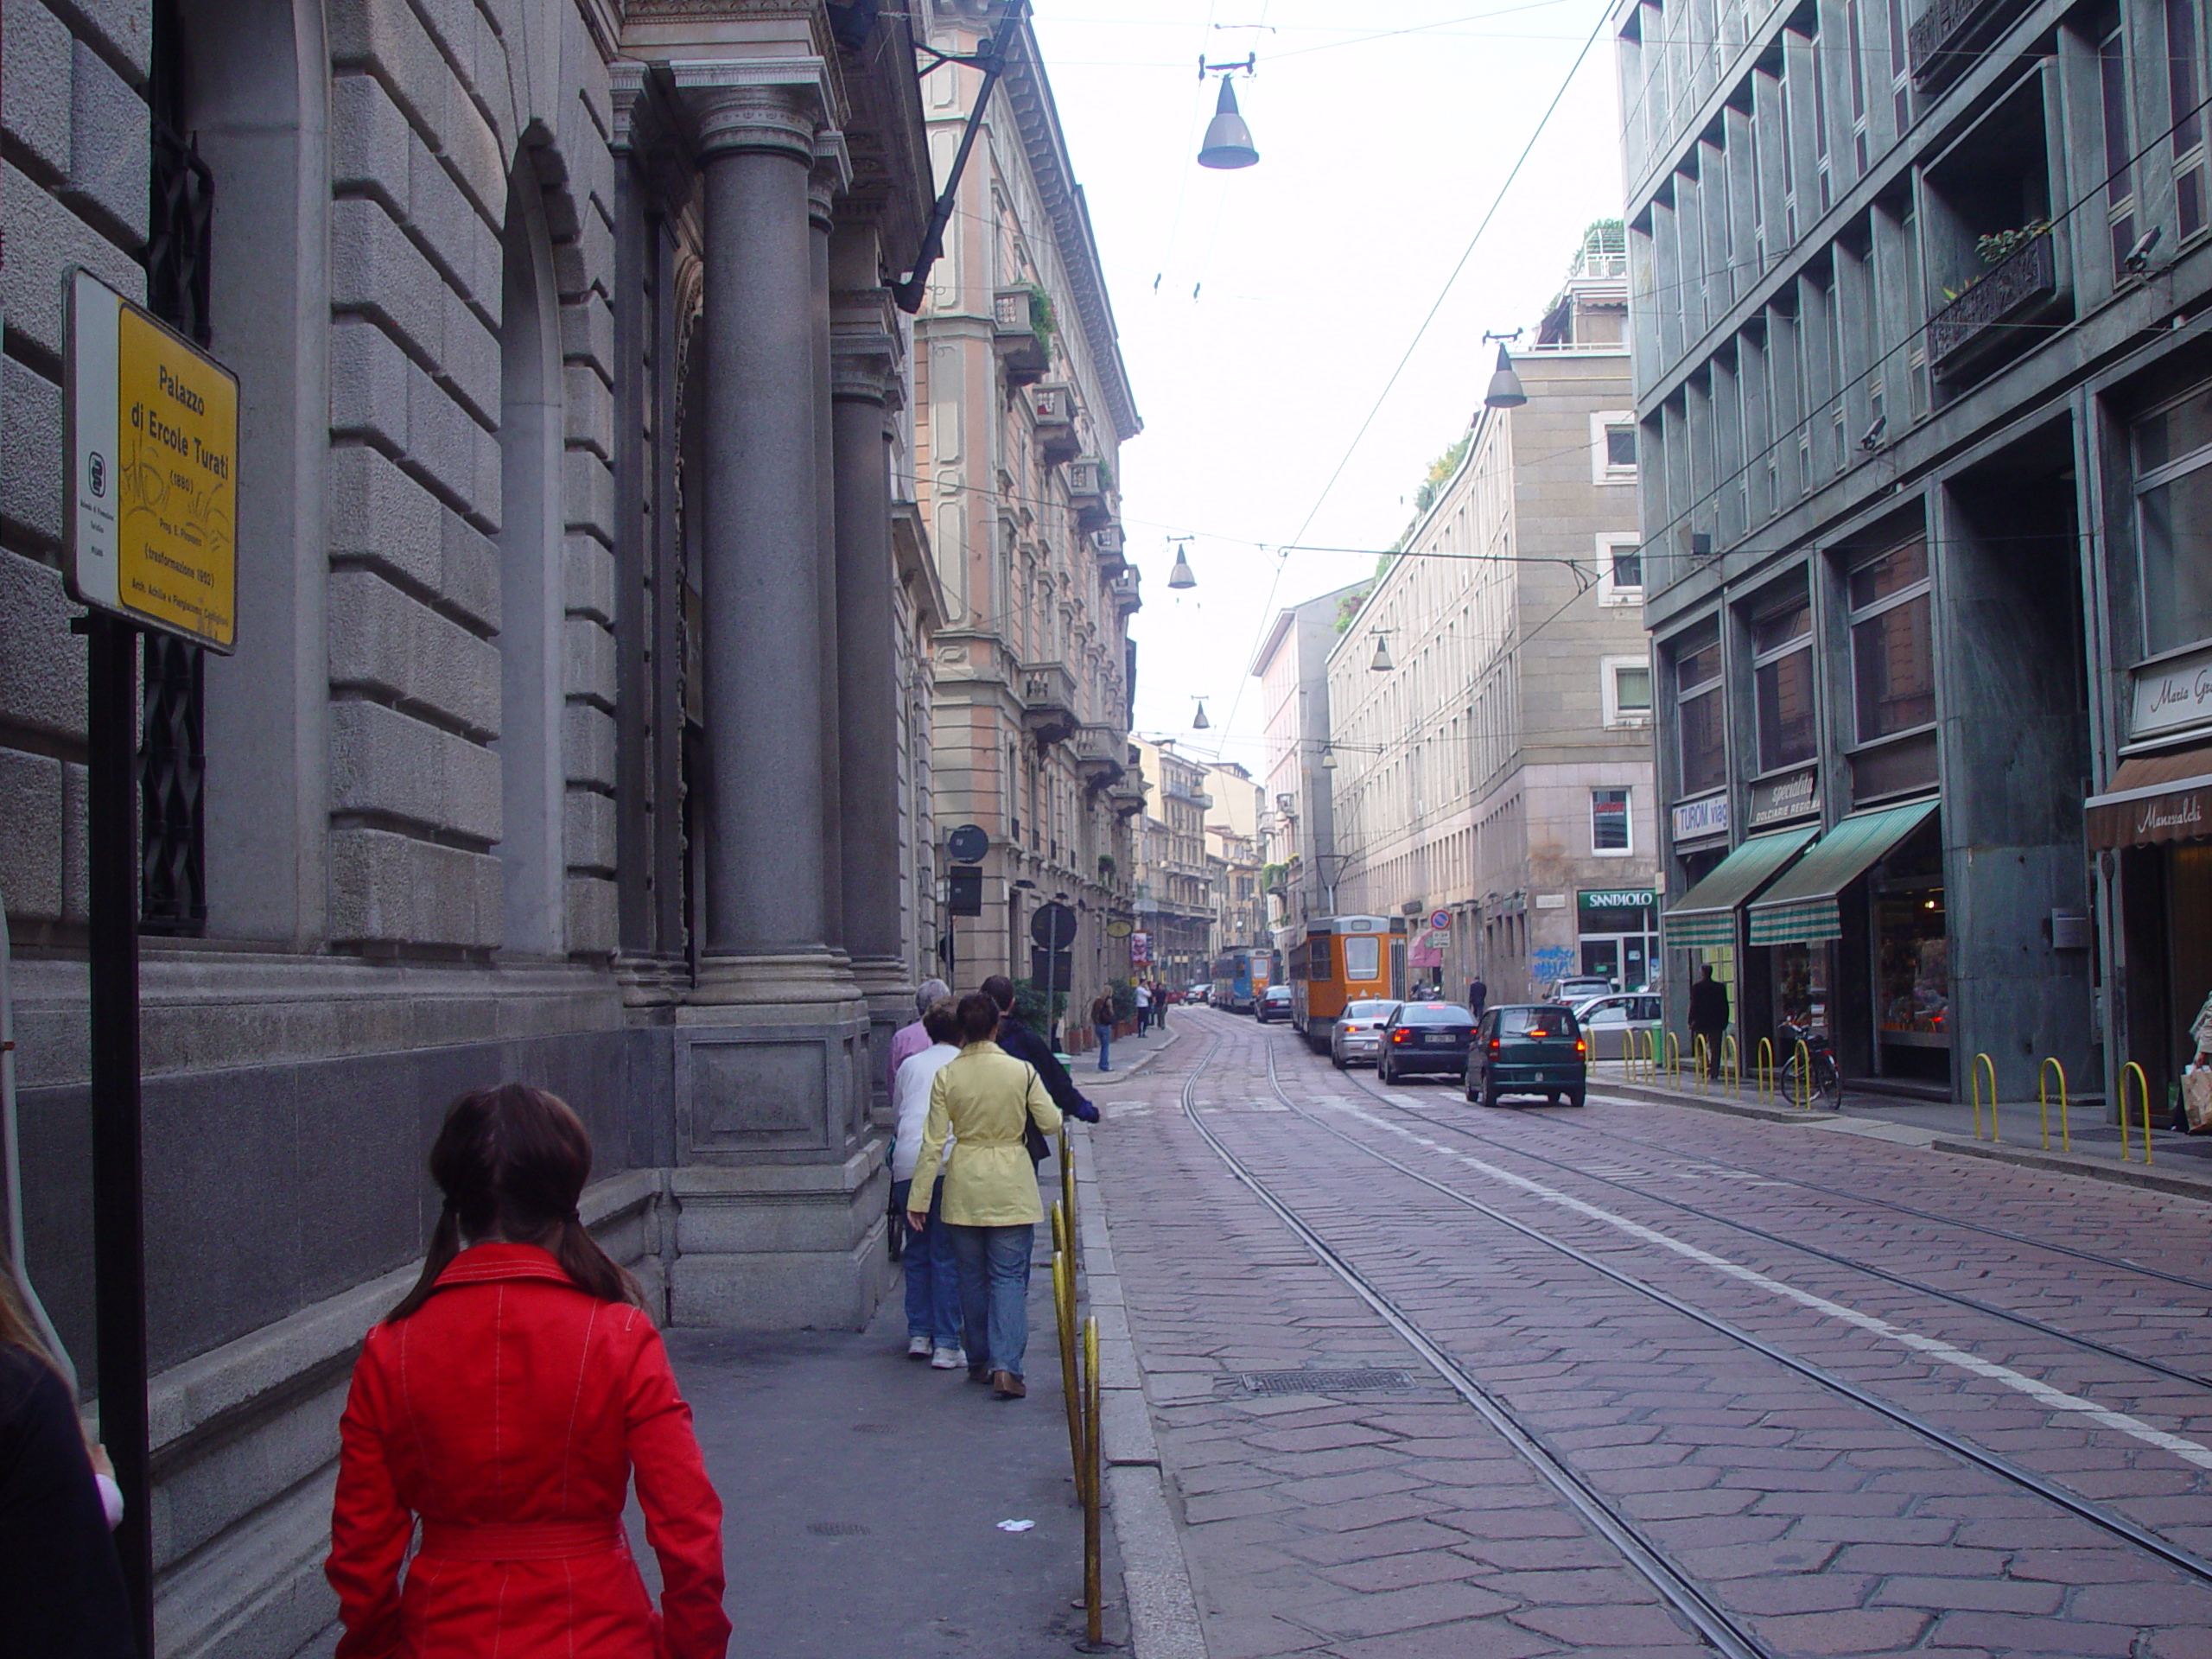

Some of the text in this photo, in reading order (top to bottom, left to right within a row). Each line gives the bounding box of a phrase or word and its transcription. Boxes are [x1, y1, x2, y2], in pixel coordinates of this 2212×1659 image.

[159, 364, 205, 416] Palazzo
[131, 402, 143, 430] di
[149, 409, 188, 456] Ercole
[194, 436, 229, 480] Turati
[2151, 679, 2189, 713] Maria
[1680, 799, 1727, 832] TUROM viag
[1589, 893, 1653, 907] SANPAOLO
